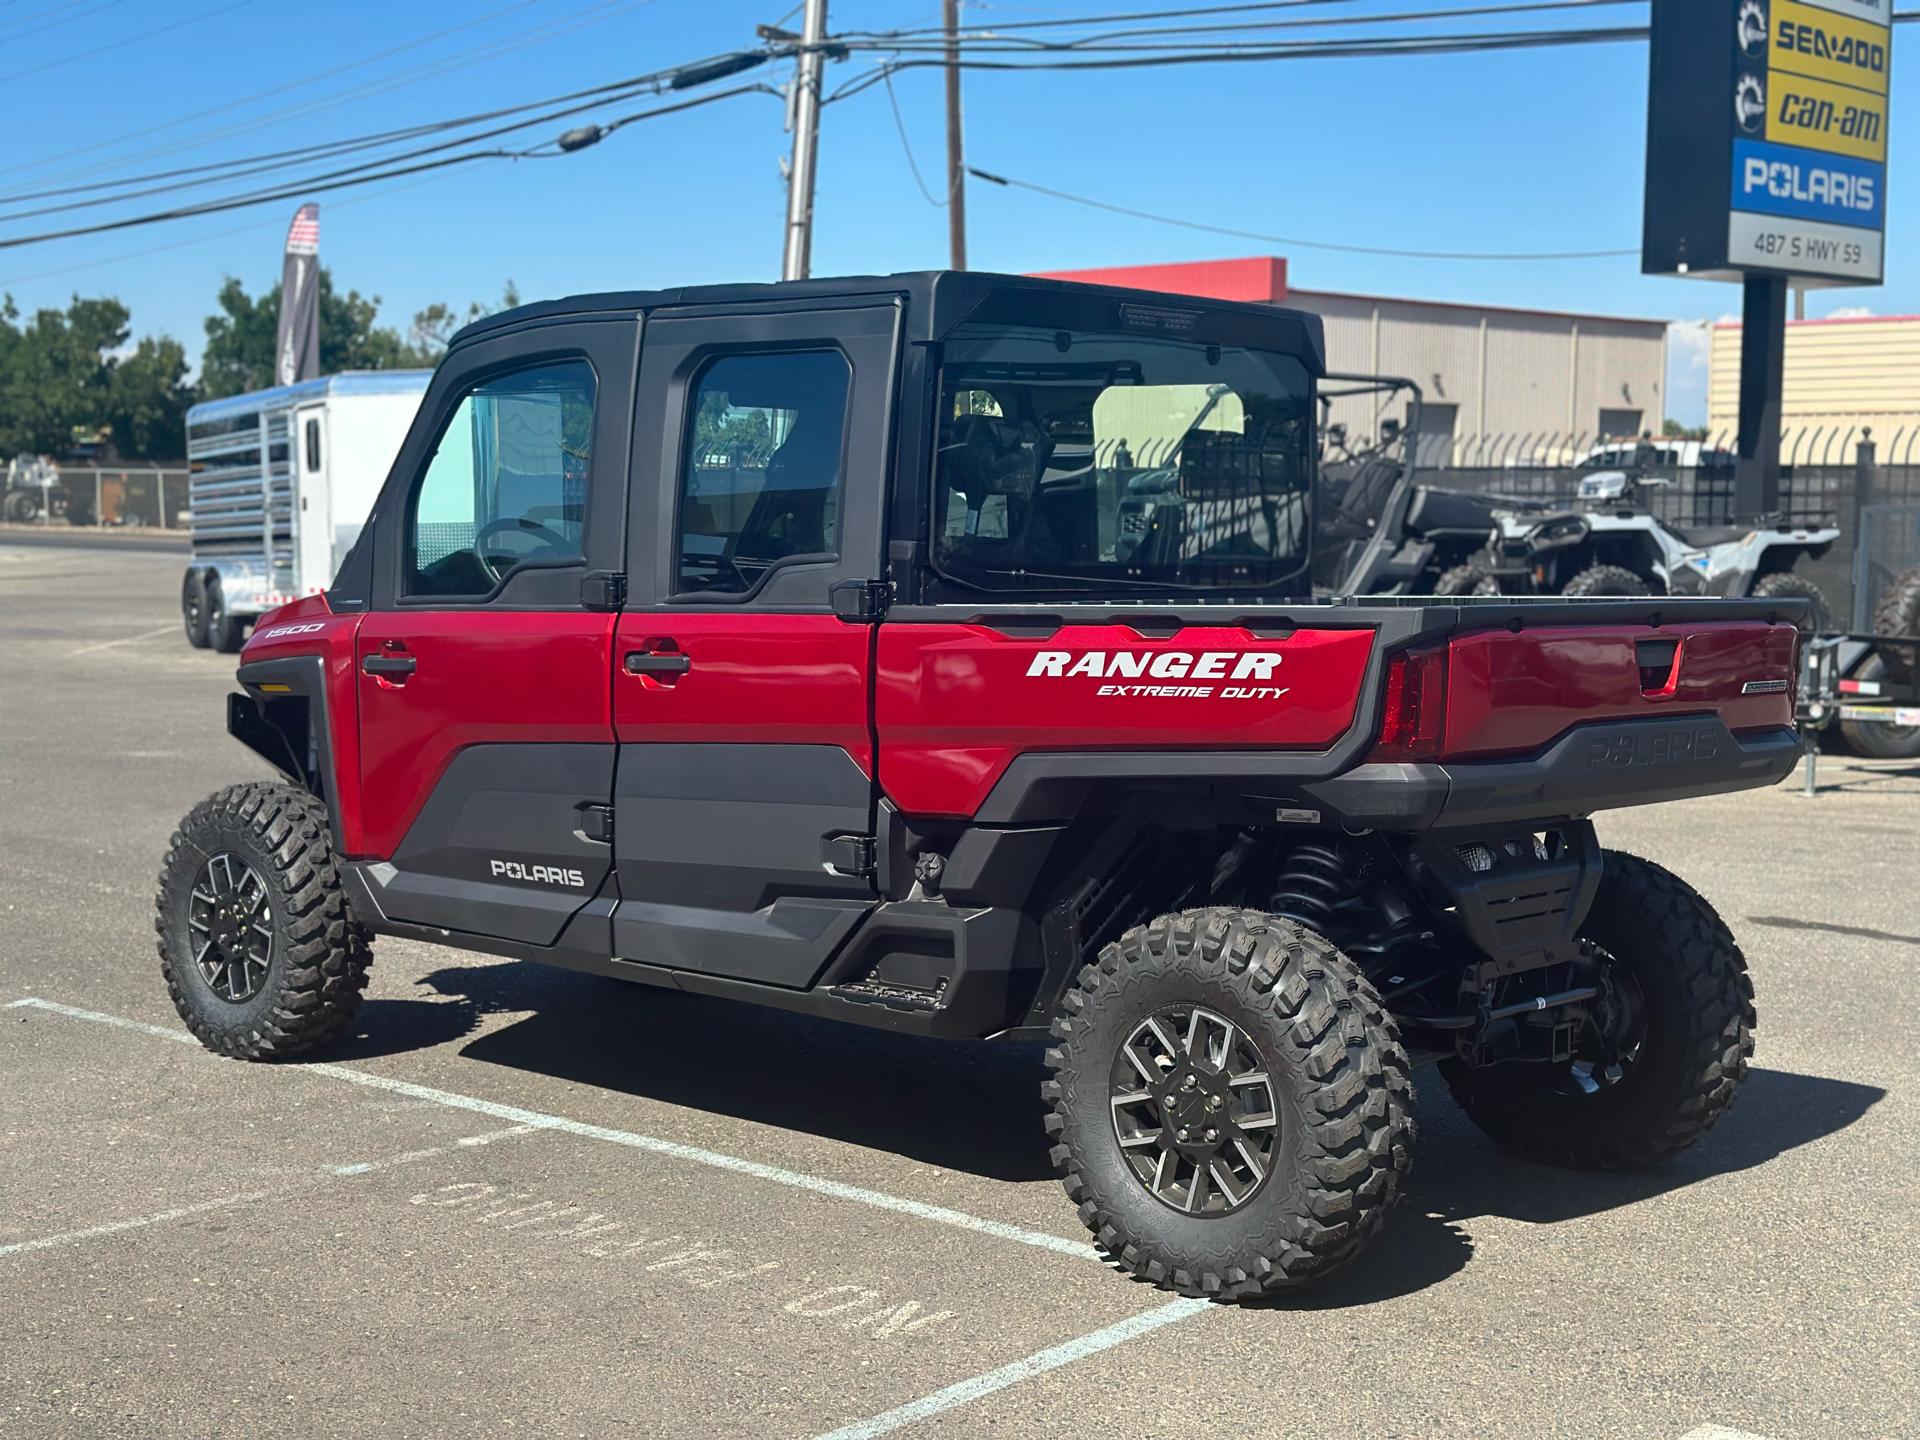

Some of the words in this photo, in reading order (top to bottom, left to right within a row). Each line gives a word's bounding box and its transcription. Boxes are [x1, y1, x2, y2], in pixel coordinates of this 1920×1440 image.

[1744, 157, 1875, 211] POLARIS
[1754, 233, 1786, 255] 487
[1791, 237, 1802, 257] S
[1806, 238, 1840, 262] HWY
[1843, 244, 1862, 264] 59
[265, 623, 326, 638] 1500
[1026, 651, 1283, 679] RANGER
[1097, 685, 1214, 698] EXTREME
[1220, 687, 1290, 699] DUTY
[1588, 727, 1717, 771] POLARIS
[490, 860, 585, 887] POLARIS
